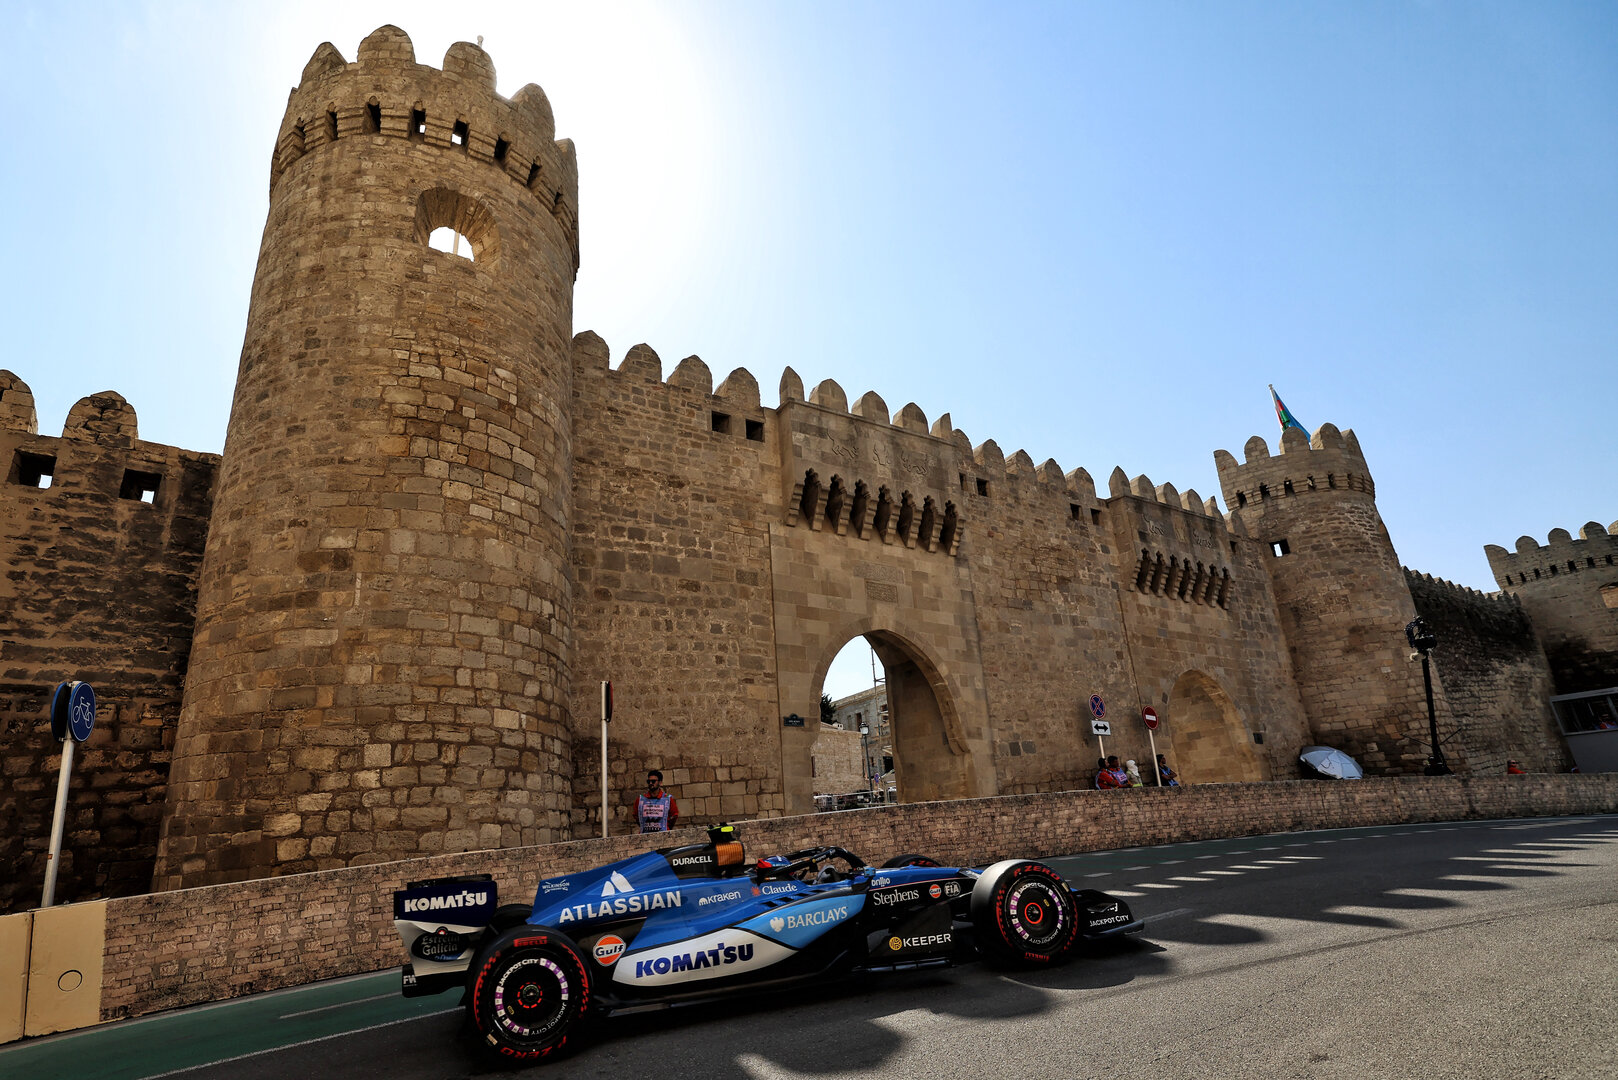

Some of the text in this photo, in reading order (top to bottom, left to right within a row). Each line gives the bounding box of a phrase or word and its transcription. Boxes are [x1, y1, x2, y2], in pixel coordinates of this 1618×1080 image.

[672, 855, 713, 867] DURACELL
[1013, 865, 1060, 881] P ZERO
[541, 882, 570, 890] WILKINSON
[762, 883, 798, 895] Claude
[1018, 882, 1037, 894] JACKPOT
[1037, 882, 1049, 891] CITY
[404, 890, 488, 913] KOMATSU
[707, 890, 741, 904] kraken
[873, 889, 920, 906] Stephens
[559, 890, 682, 924] ATLASSIAN
[787, 906, 848, 930] BARCLAYS
[1089, 914, 1129, 927] JACKPOT CITY
[903, 933, 952, 948] KEEPER
[422, 942, 459, 956] Galicia
[595, 944, 624, 957] Gulf
[635, 942, 754, 979] KOMATSU
[498, 958, 540, 987] JACKPOT CITY
[531, 1027, 548, 1036] CITY
